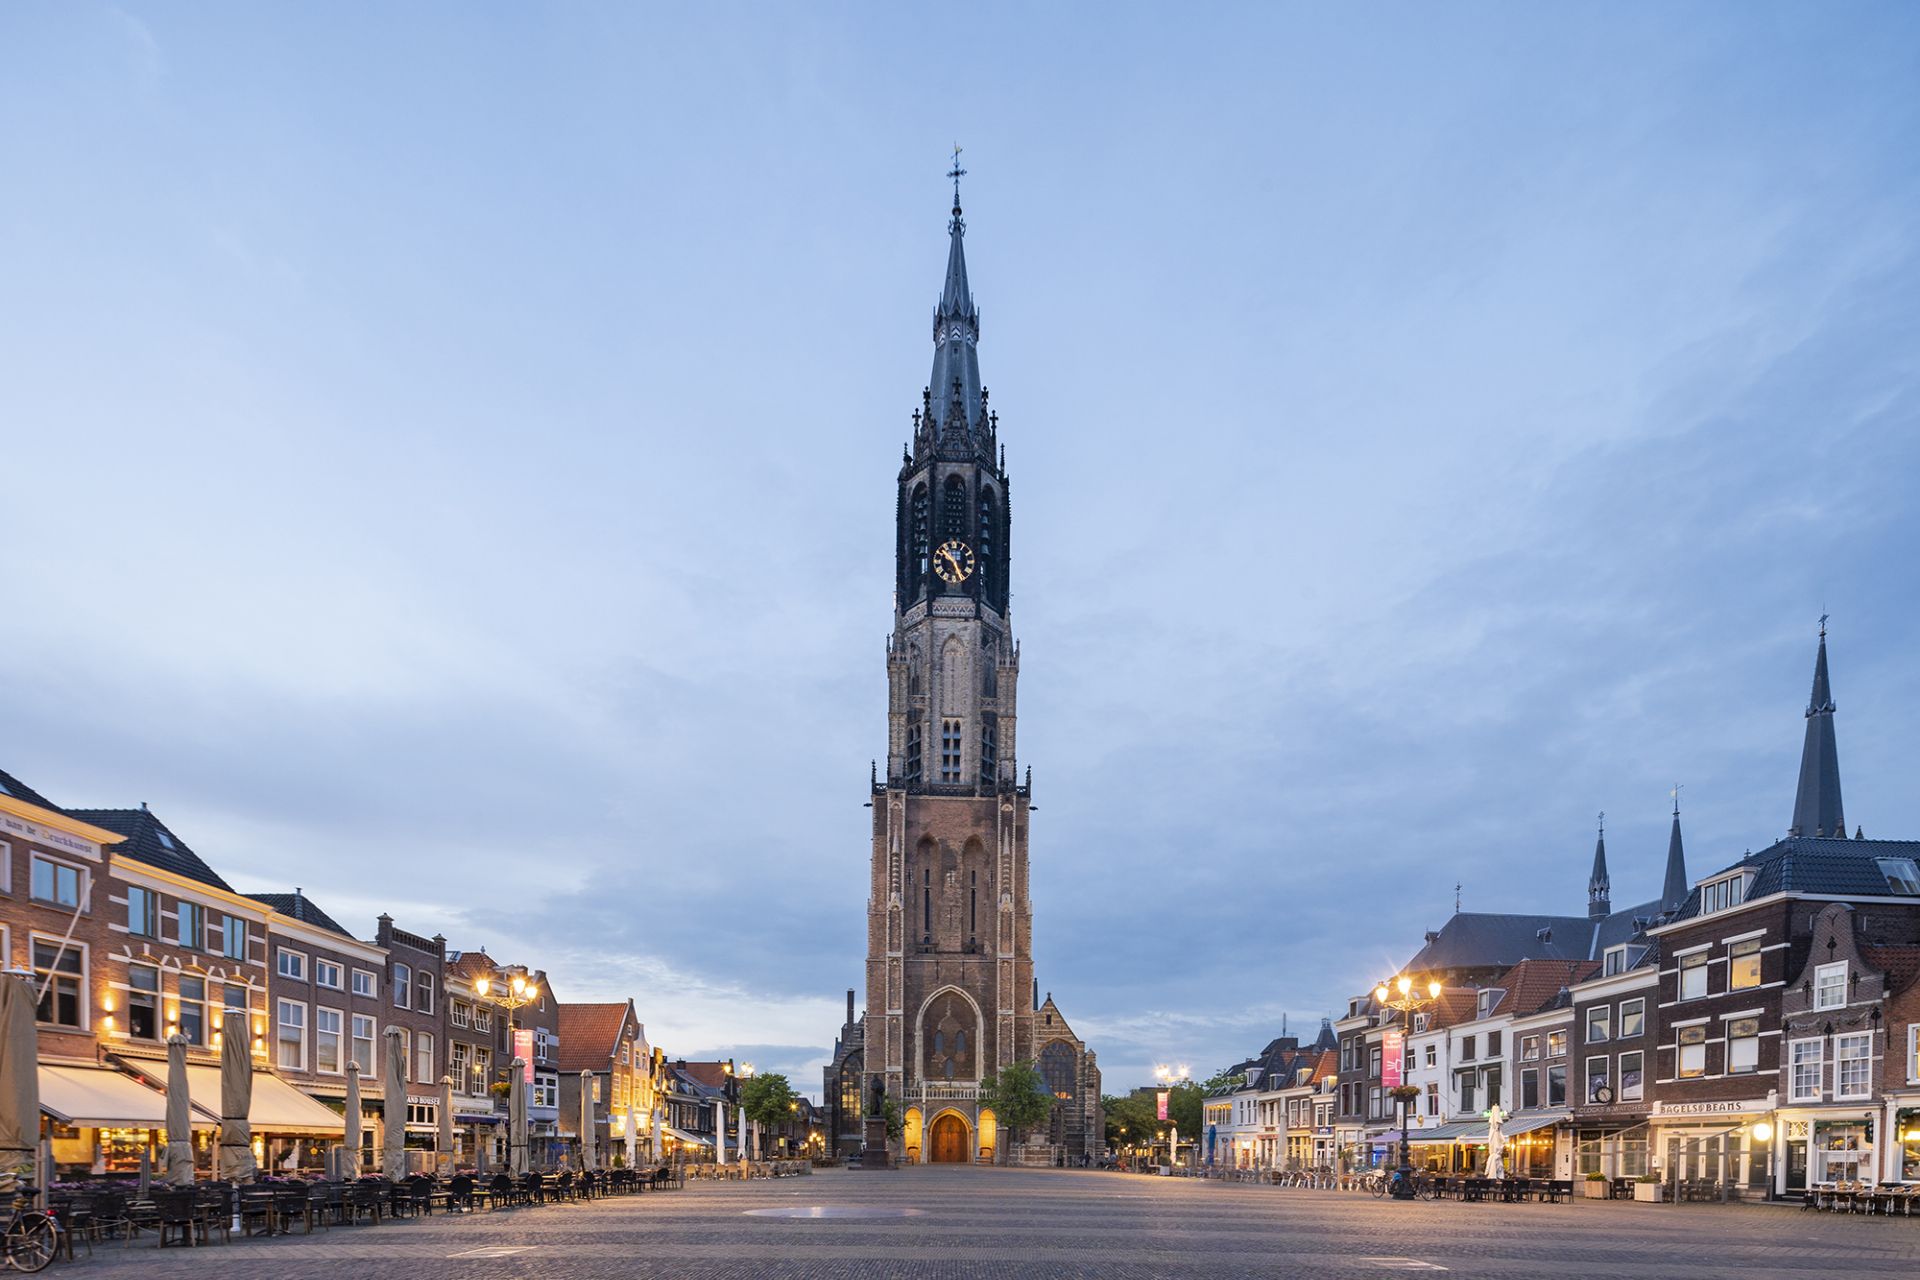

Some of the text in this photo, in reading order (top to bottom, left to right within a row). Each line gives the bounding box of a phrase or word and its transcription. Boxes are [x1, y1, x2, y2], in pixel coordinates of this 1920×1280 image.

[1612, 1104, 1648, 1113] WATCHES
[1660, 1104, 1699, 1114] BAGELS
[1705, 1102, 1742, 1112] BEANS
